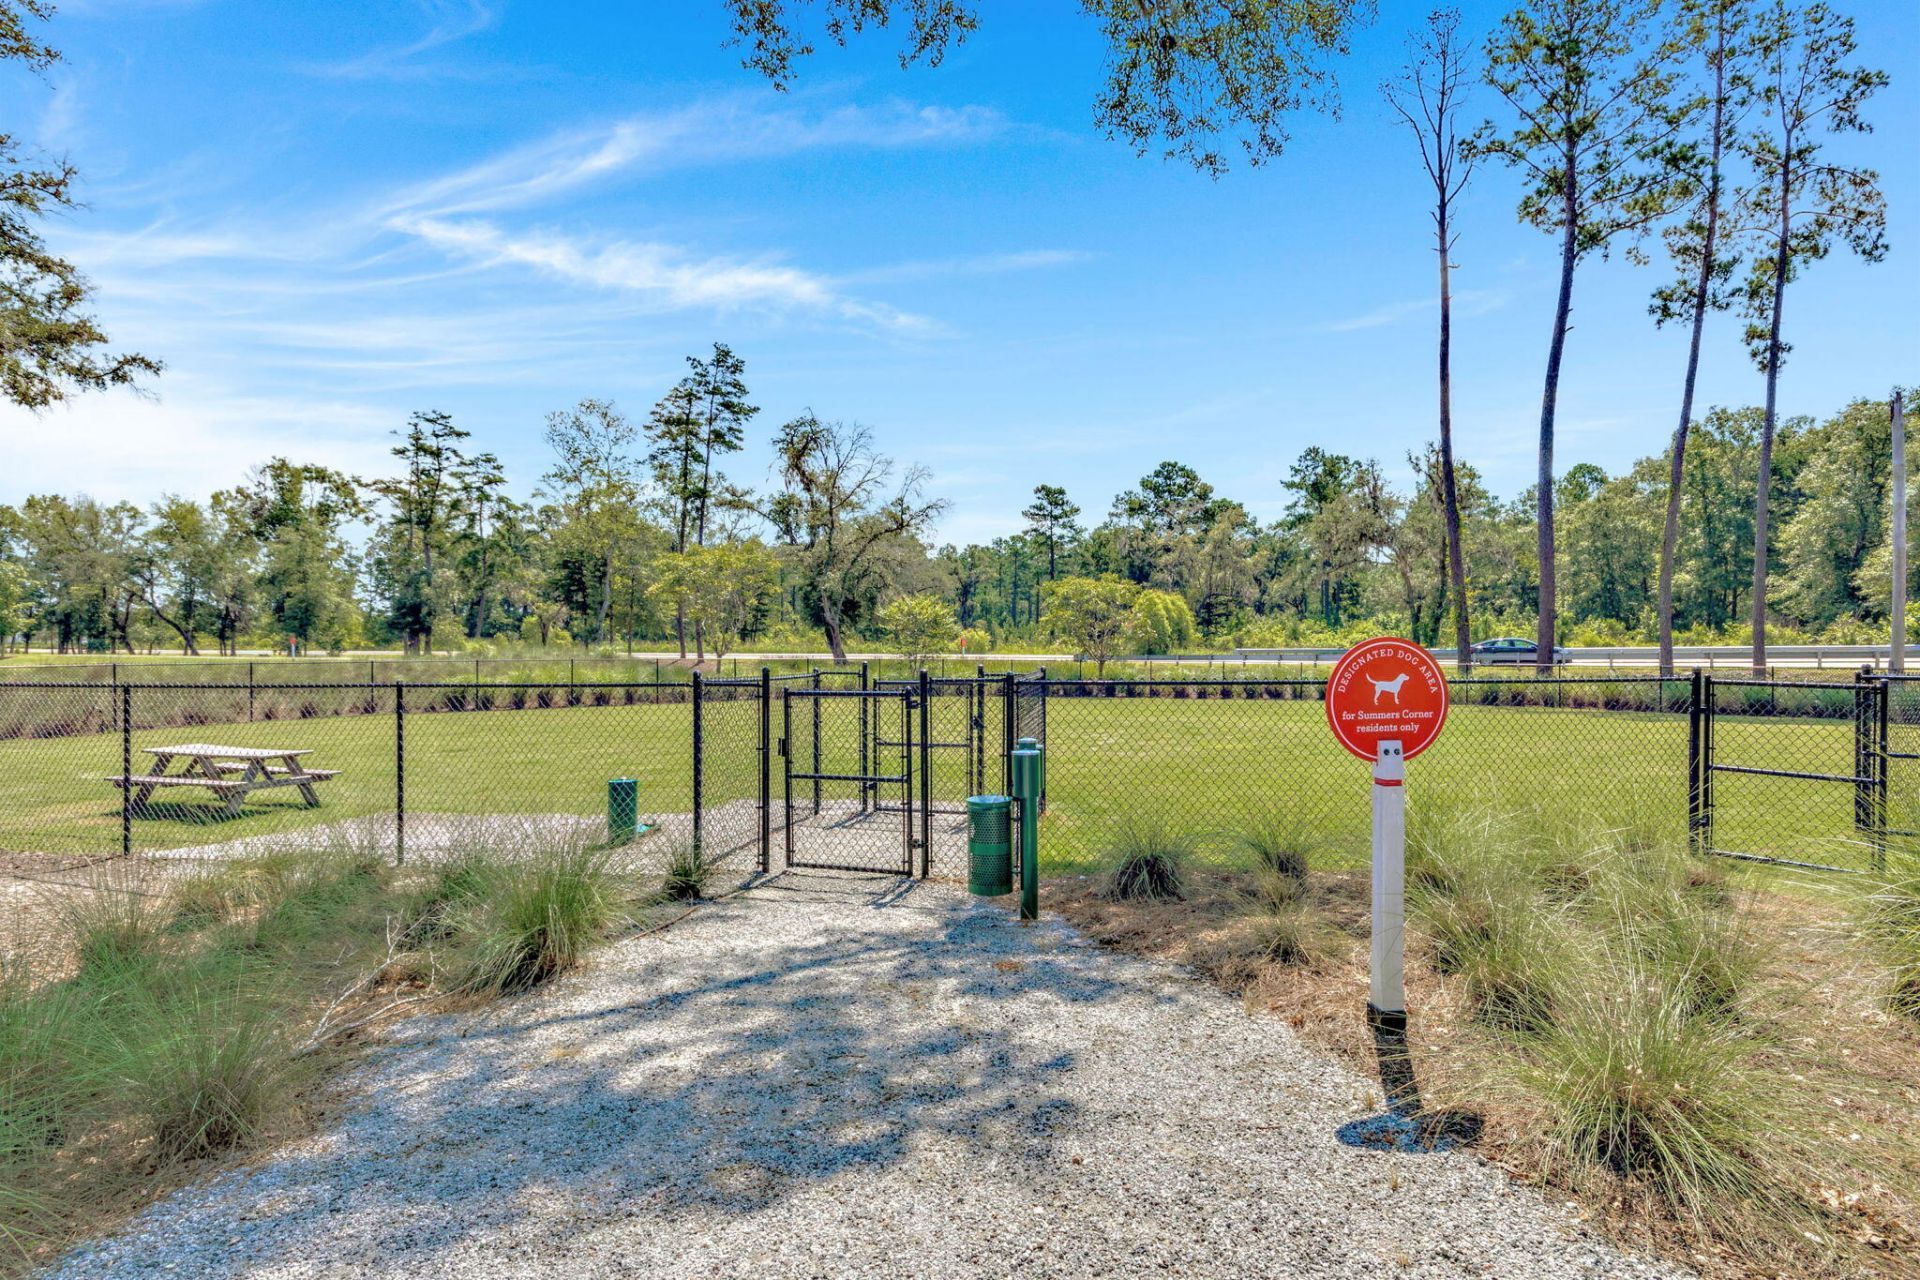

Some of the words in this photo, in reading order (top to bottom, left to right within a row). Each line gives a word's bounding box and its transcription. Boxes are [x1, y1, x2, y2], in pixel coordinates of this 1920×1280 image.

[1338, 648, 1394, 693] DESIGNATED
[1397, 650, 1420, 665] DOG
[1419, 665, 1438, 694] AREA
[1342, 711, 1355, 720] for
[1358, 711, 1399, 720] Summers
[1402, 709, 1433, 719] Corner
[1356, 723, 1398, 732] residents
[1400, 722, 1420, 733] only
